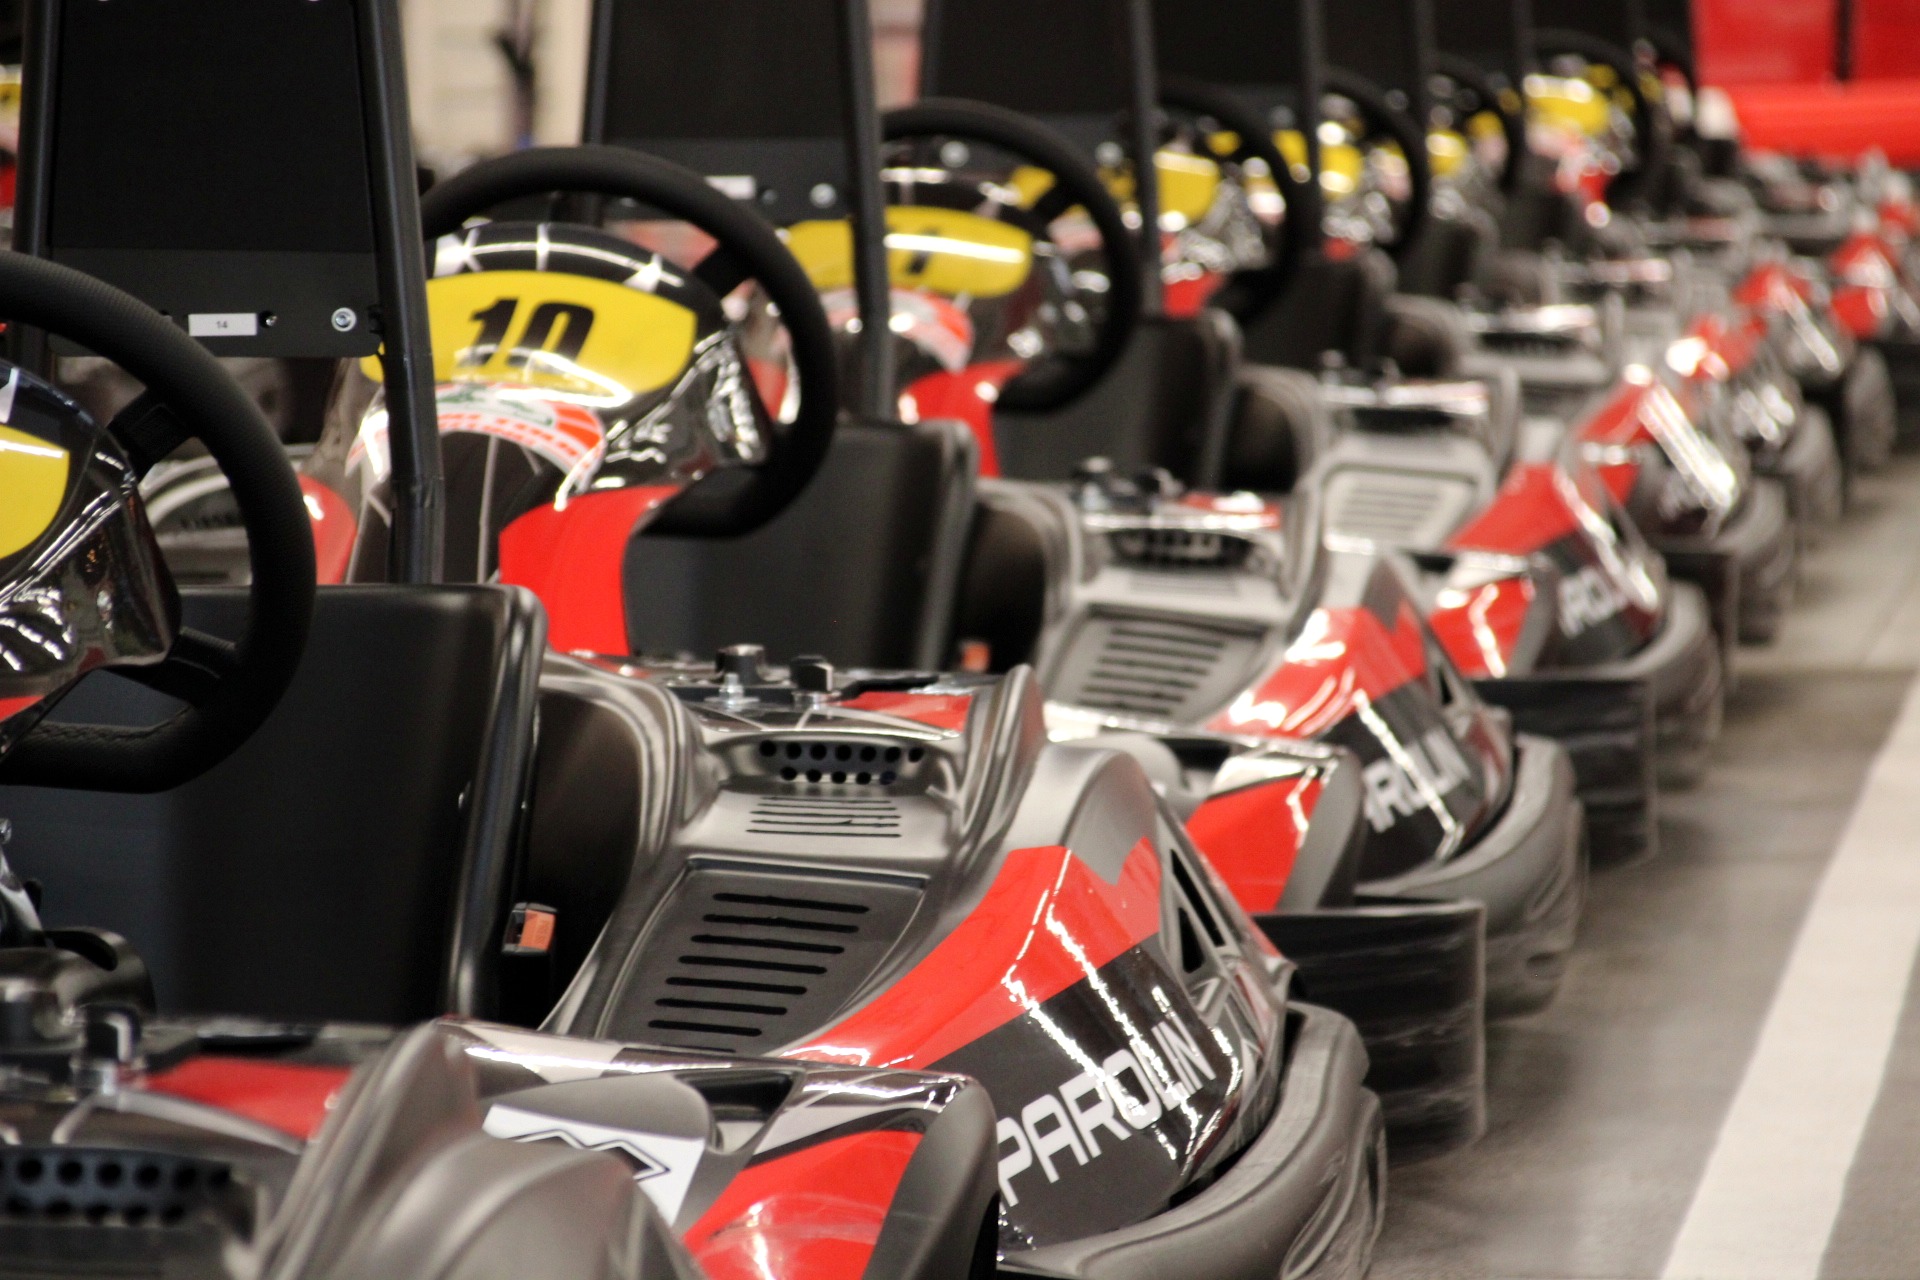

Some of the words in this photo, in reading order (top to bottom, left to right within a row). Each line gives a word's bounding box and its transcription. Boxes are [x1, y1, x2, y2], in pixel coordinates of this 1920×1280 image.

[216, 320, 228, 329] 14
[461, 297, 594, 373] 10
[996, 1009, 1217, 1207] PAROLIN
